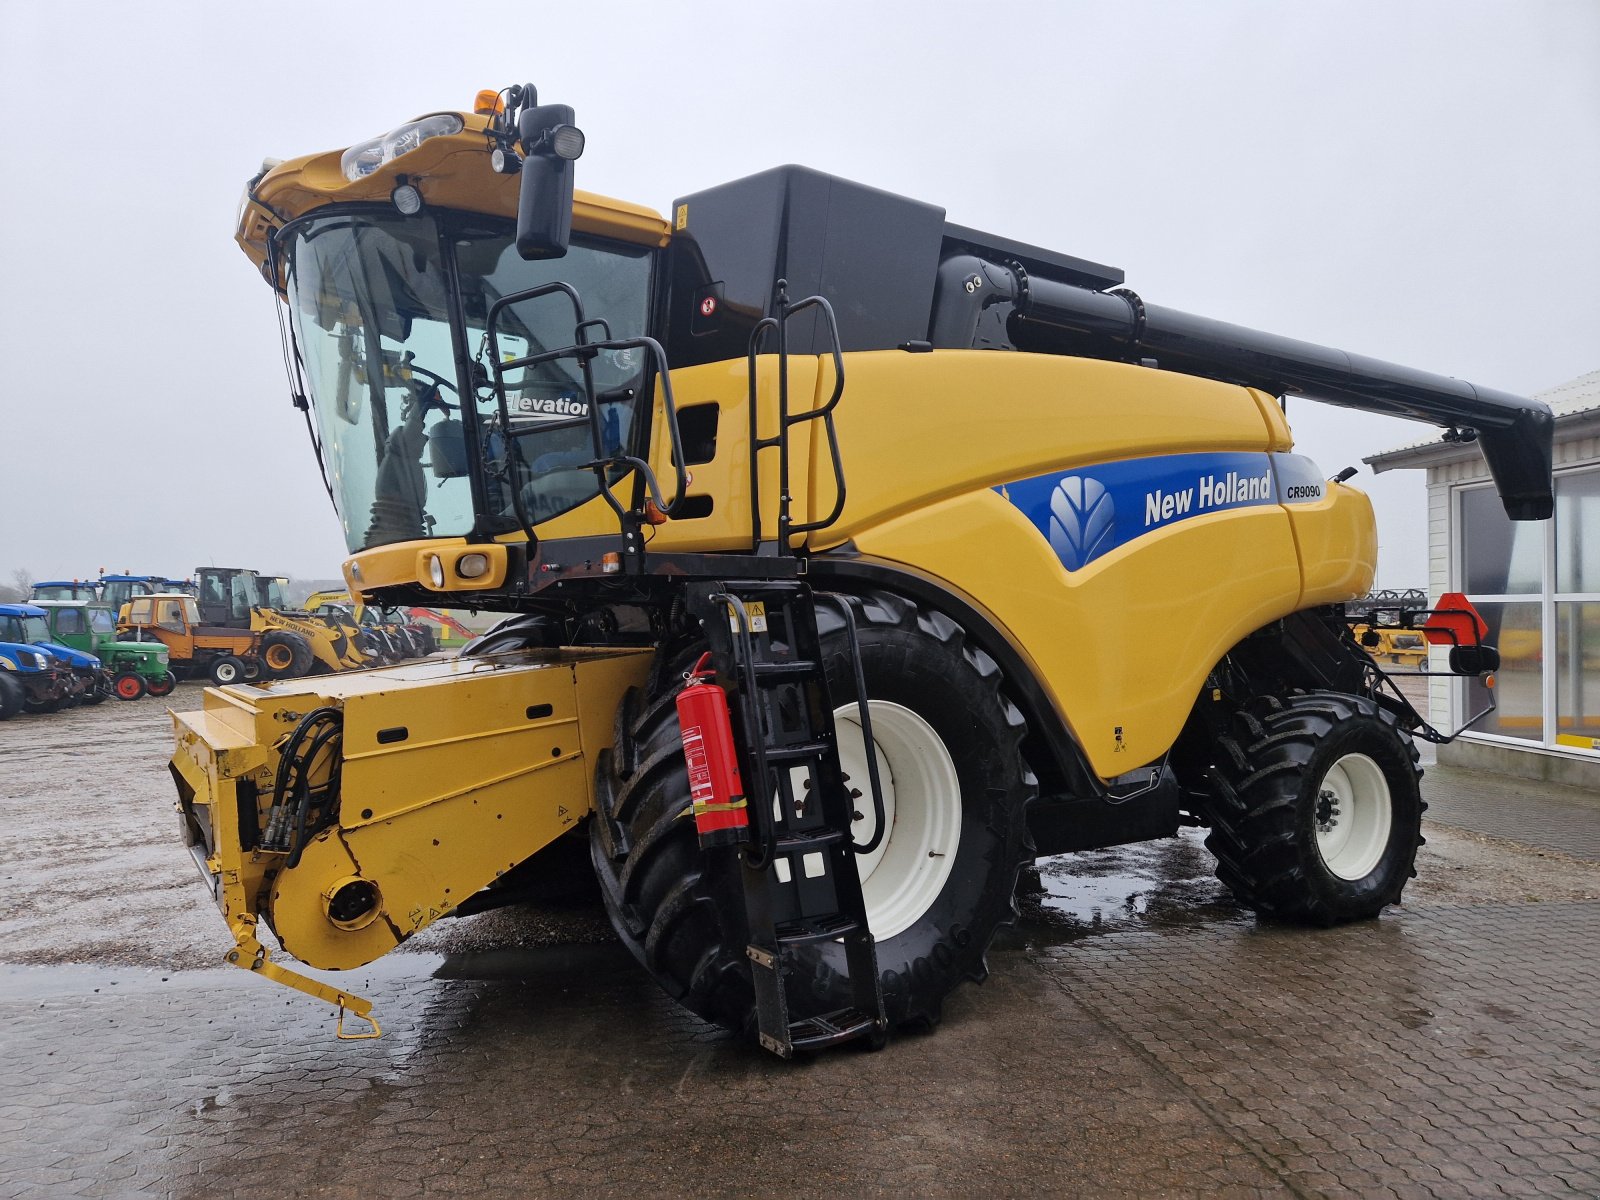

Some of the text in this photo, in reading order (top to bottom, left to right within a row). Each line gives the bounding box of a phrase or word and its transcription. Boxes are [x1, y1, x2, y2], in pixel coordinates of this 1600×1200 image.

[1145, 469, 1271, 526] New Holland
[1287, 485, 1321, 499] CR9090
[269, 615, 285, 625] NEW
[285, 621, 315, 637] HOLLAND
